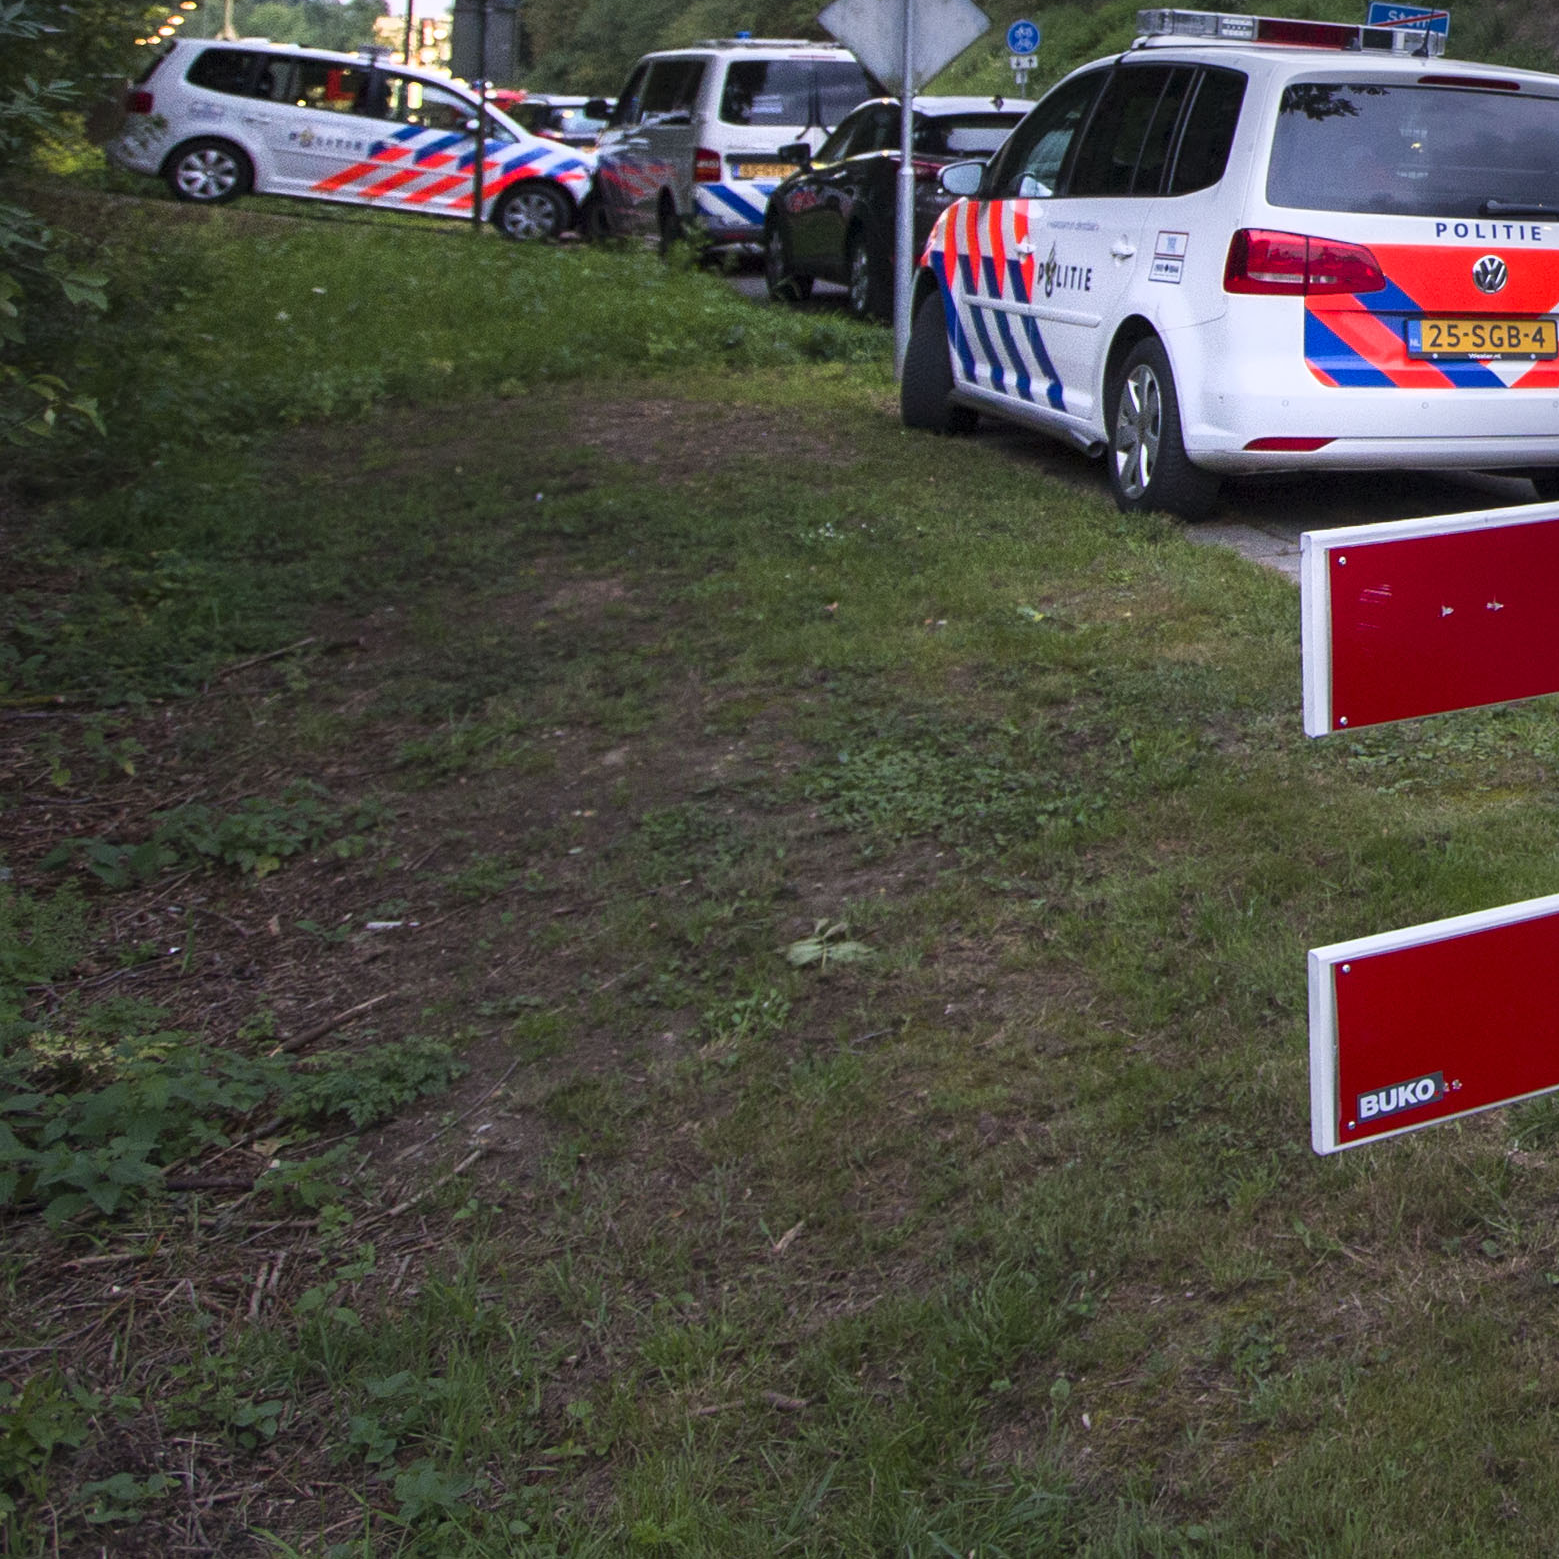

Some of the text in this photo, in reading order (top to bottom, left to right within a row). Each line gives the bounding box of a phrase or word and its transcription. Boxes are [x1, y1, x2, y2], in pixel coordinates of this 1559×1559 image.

[1435, 222, 1542, 241] POLITIE
[1037, 252, 1092, 298] POLITIE
[1429, 323, 1546, 349] 25-SGB-4
